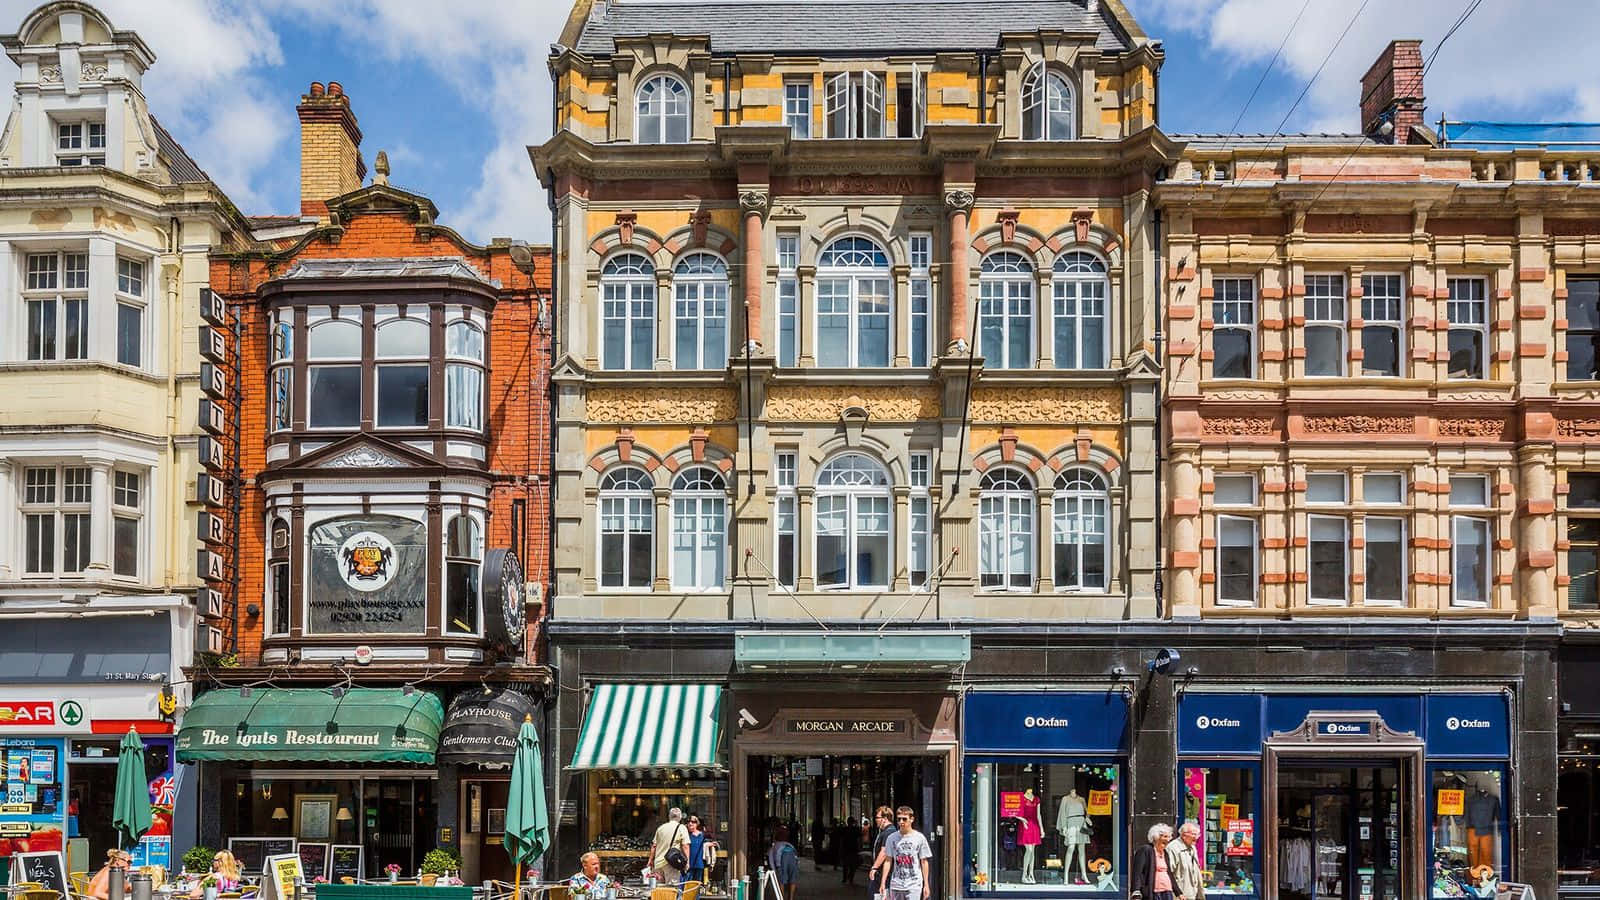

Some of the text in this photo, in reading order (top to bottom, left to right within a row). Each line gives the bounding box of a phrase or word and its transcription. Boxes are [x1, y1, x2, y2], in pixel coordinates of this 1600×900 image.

[210, 290, 225, 651] RESTAURANT
[331, 612, 362, 622] 02920
[104, 672, 113, 680] 31
[125, 672, 140, 681] Mary
[450, 708, 512, 721] PLAYHOUSE
[796, 721, 895, 732] MORGAN ARCADE
[1036, 717, 1068, 727] Oxfam
[1211, 718, 1241, 727] Oxfam
[1461, 719, 1491, 728] Oxfam
[202, 729, 229, 745] The
[284, 729, 380, 745] Restaurant
[443, 734, 517, 747] Gentlemens Club
[6, 739, 36, 747] Lebara
[34, 857, 44, 868] 2
[28, 867, 56, 878] MEALS
